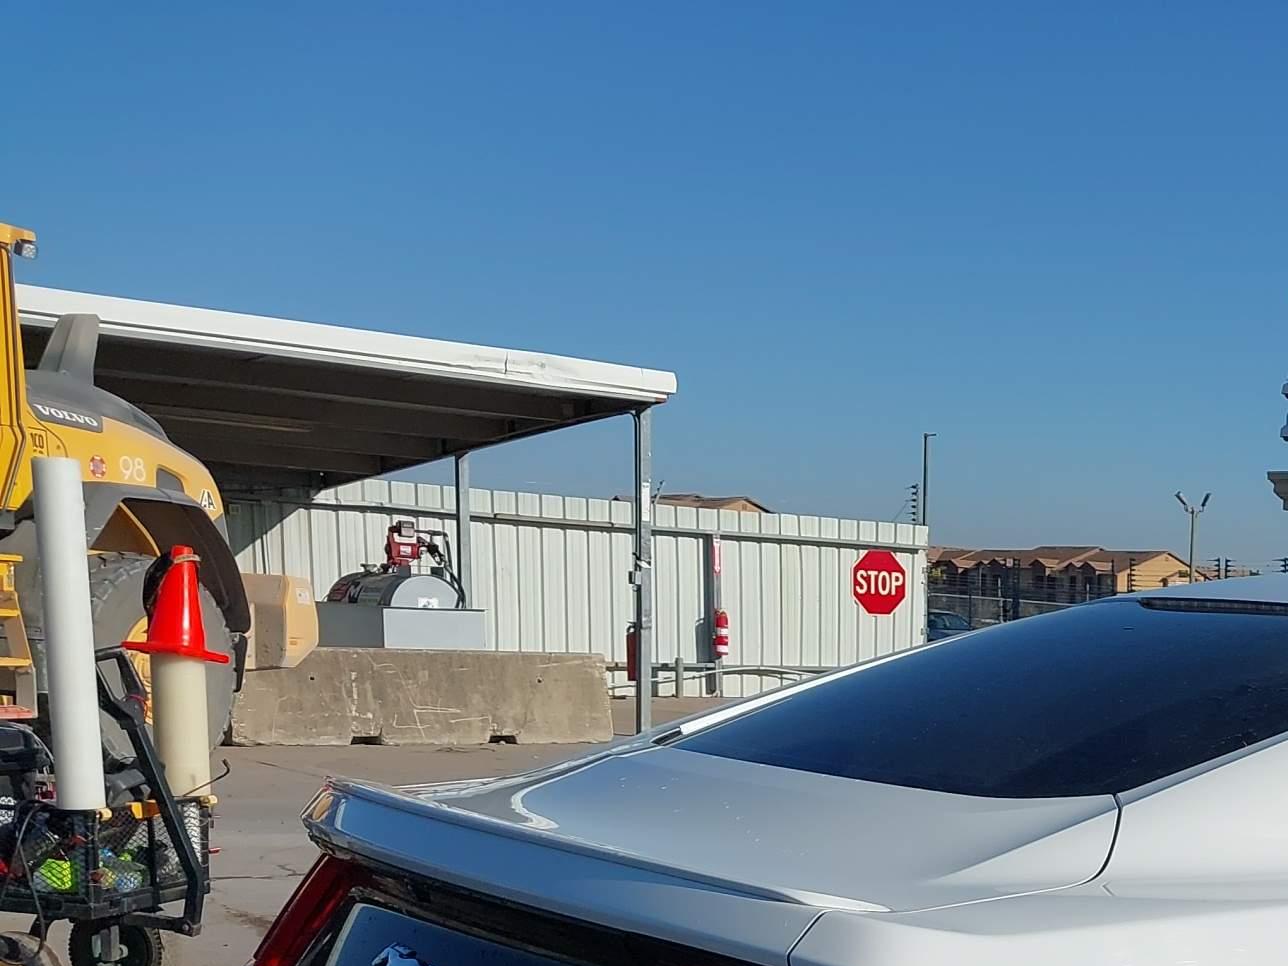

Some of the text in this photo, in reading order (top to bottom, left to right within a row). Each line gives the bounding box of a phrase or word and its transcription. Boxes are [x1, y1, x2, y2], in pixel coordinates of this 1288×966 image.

[33, 403, 98, 427] VOLVO
[119, 456, 146, 481] 98
[855, 569, 904, 596] STOP
